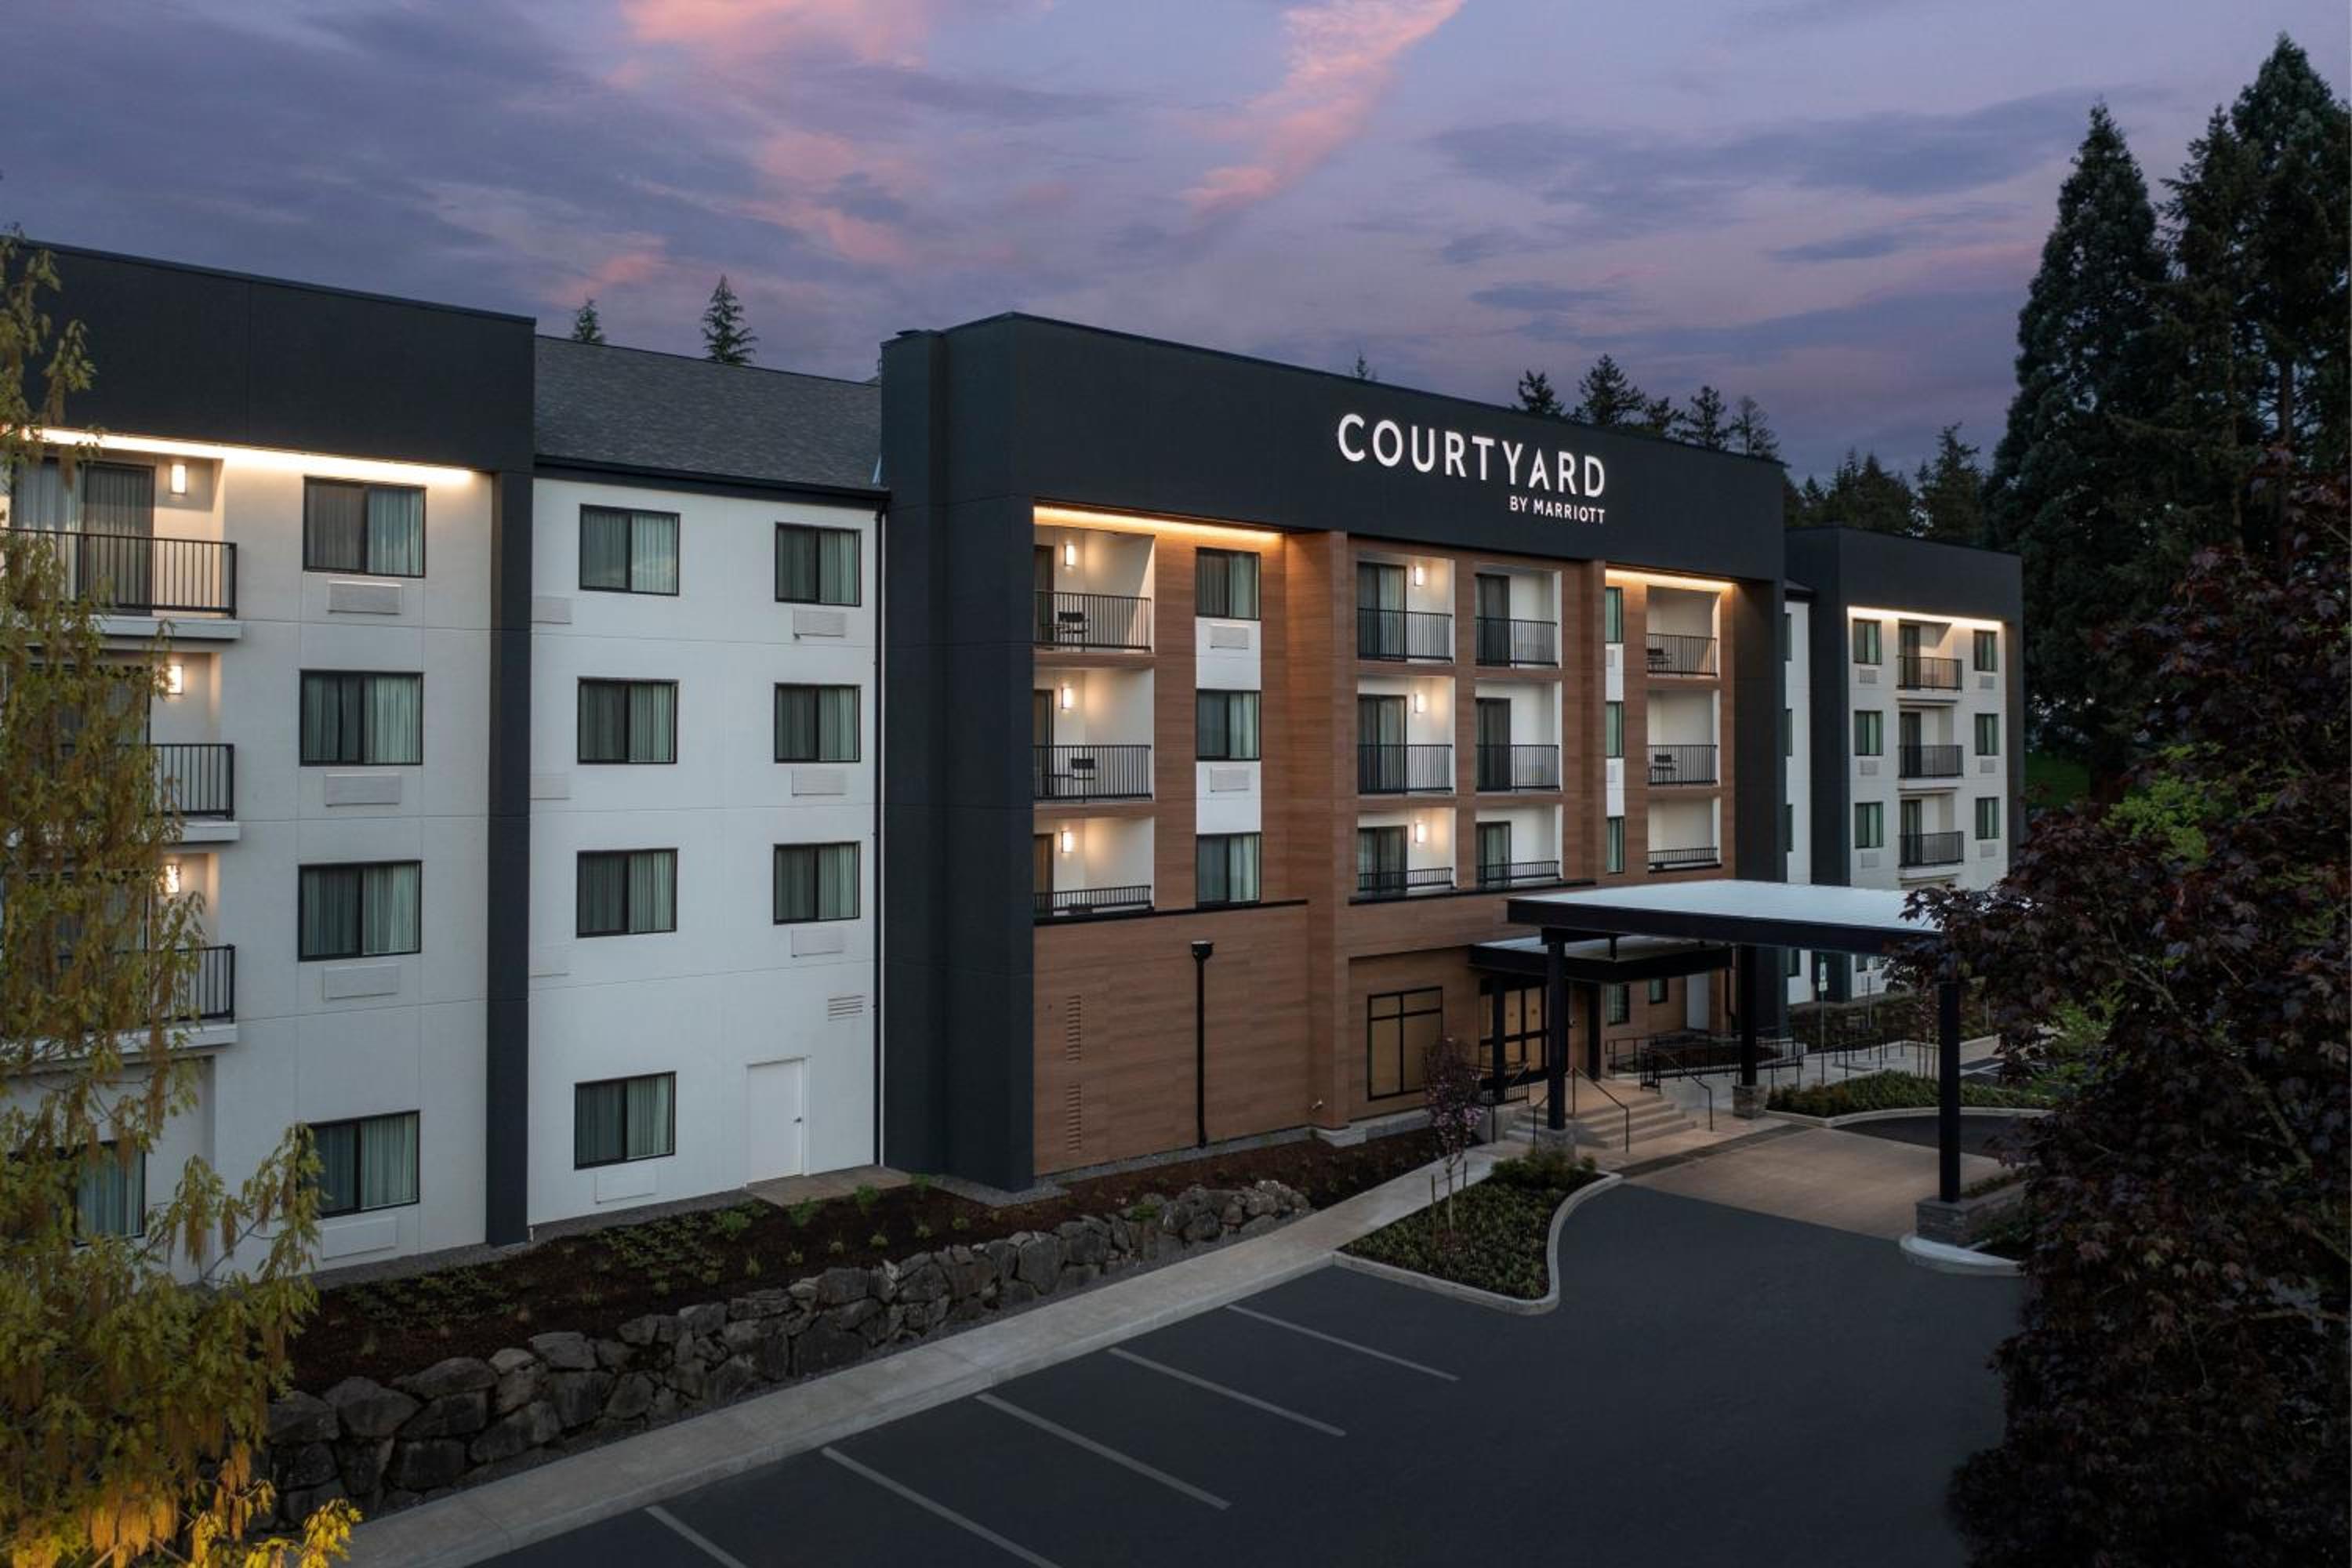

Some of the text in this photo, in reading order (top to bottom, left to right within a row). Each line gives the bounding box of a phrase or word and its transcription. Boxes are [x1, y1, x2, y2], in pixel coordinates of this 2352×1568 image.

[1338, 413, 1606, 498] COURTYARD
[1509, 495, 1606, 524] BY MARRIOTT
